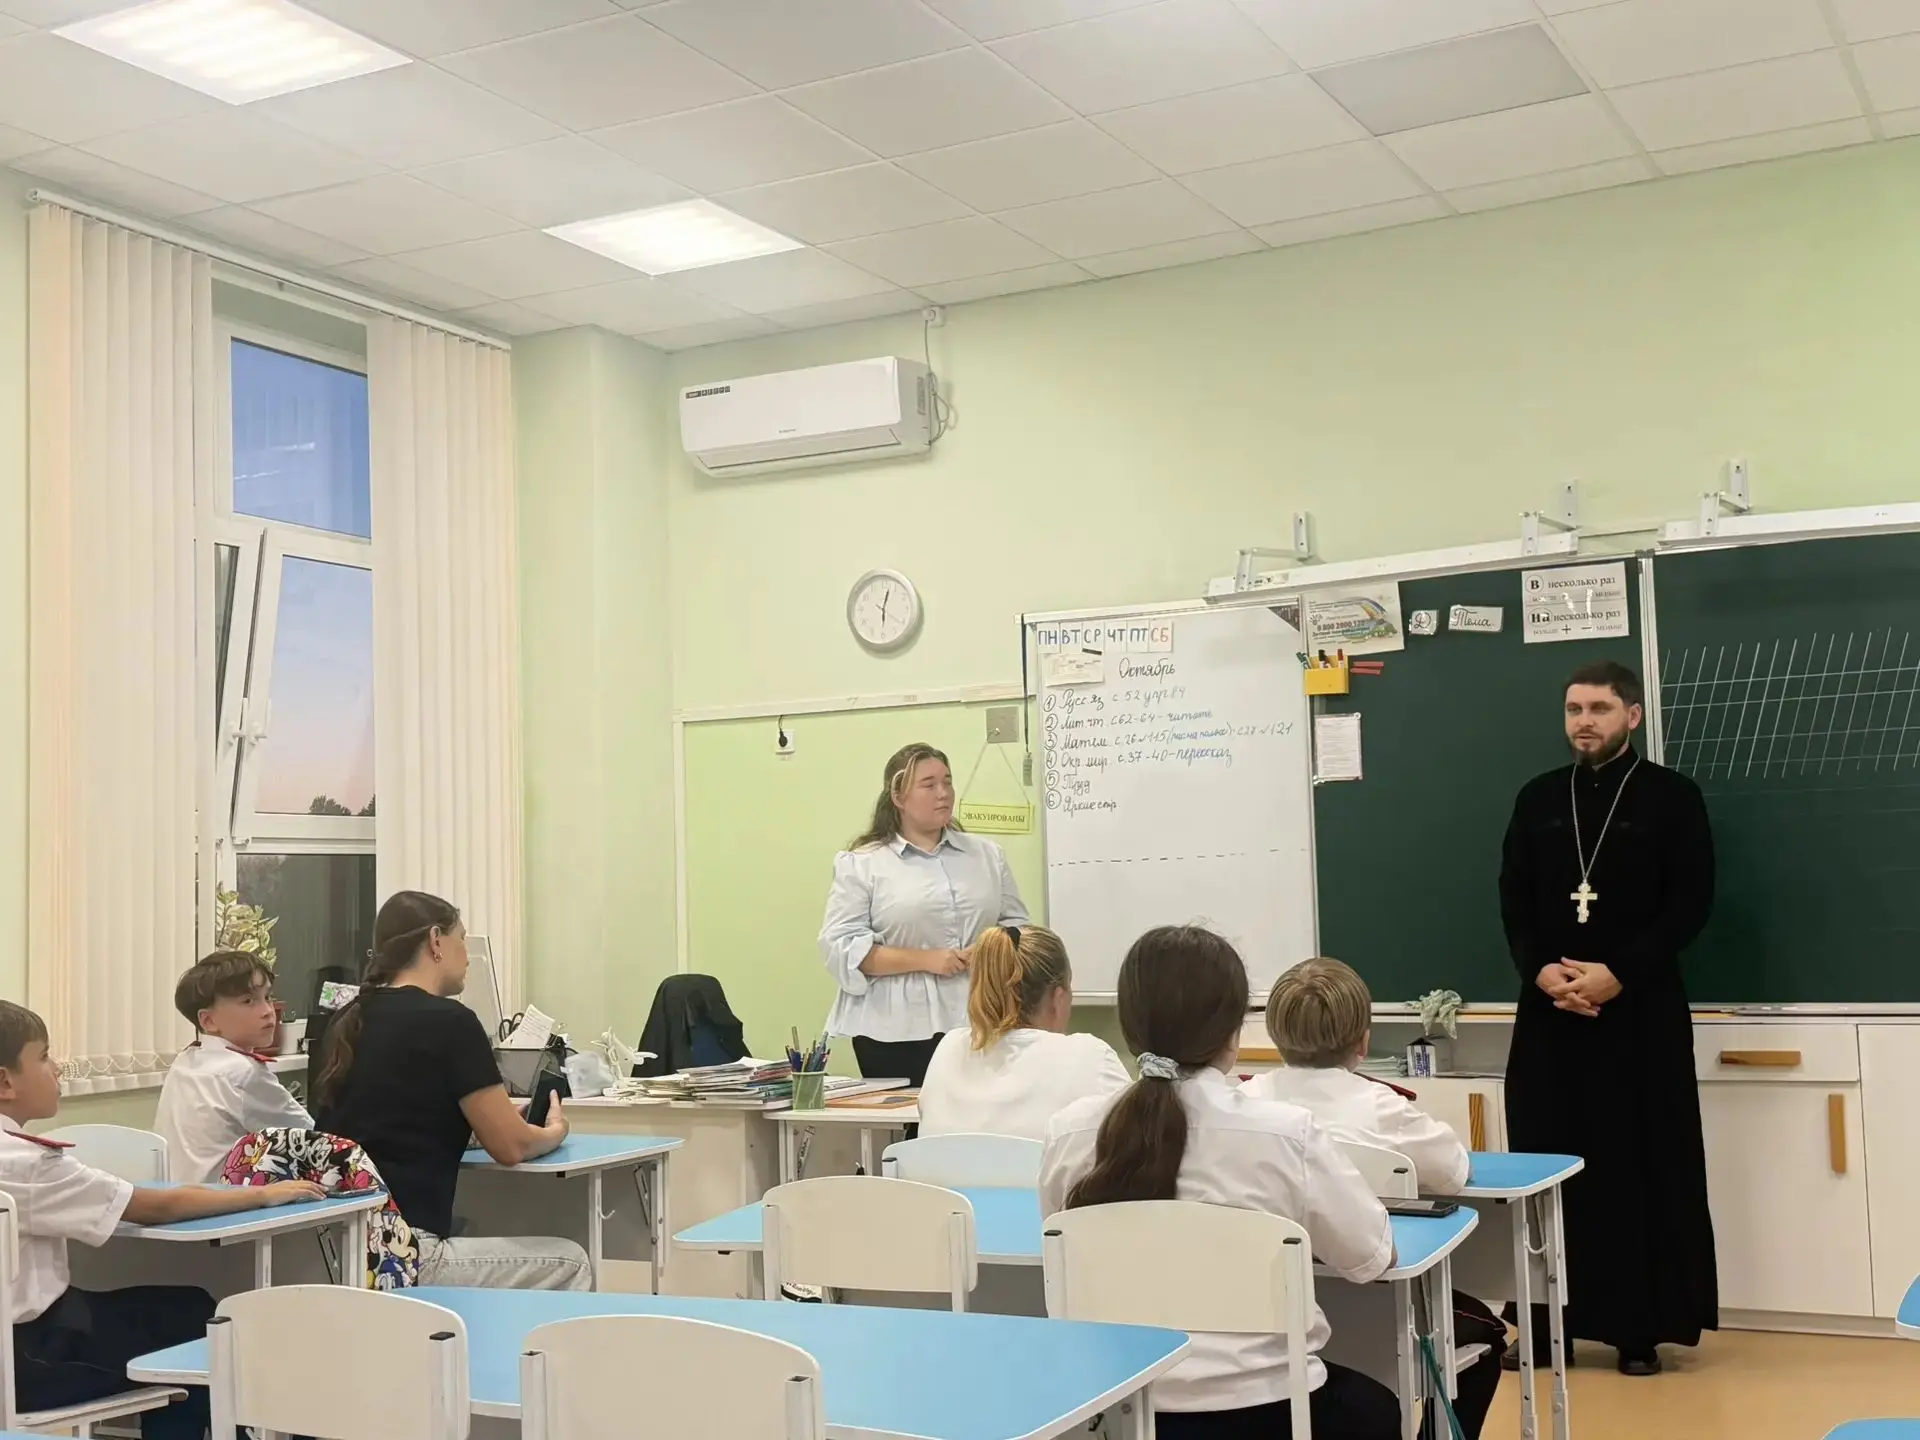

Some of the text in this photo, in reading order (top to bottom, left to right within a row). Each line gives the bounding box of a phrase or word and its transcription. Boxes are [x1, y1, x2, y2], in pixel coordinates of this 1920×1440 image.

[1548, 578, 1598, 589] несколько
[1600, 576, 1616, 587] раз
[1553, 611, 1603, 622] несколько
[1605, 610, 1621, 621] раз
[1038, 627, 1169, 645] ПН ВТ СР ЧТ ПТ СБ
[1119, 657, 1176, 684] Октябрь
